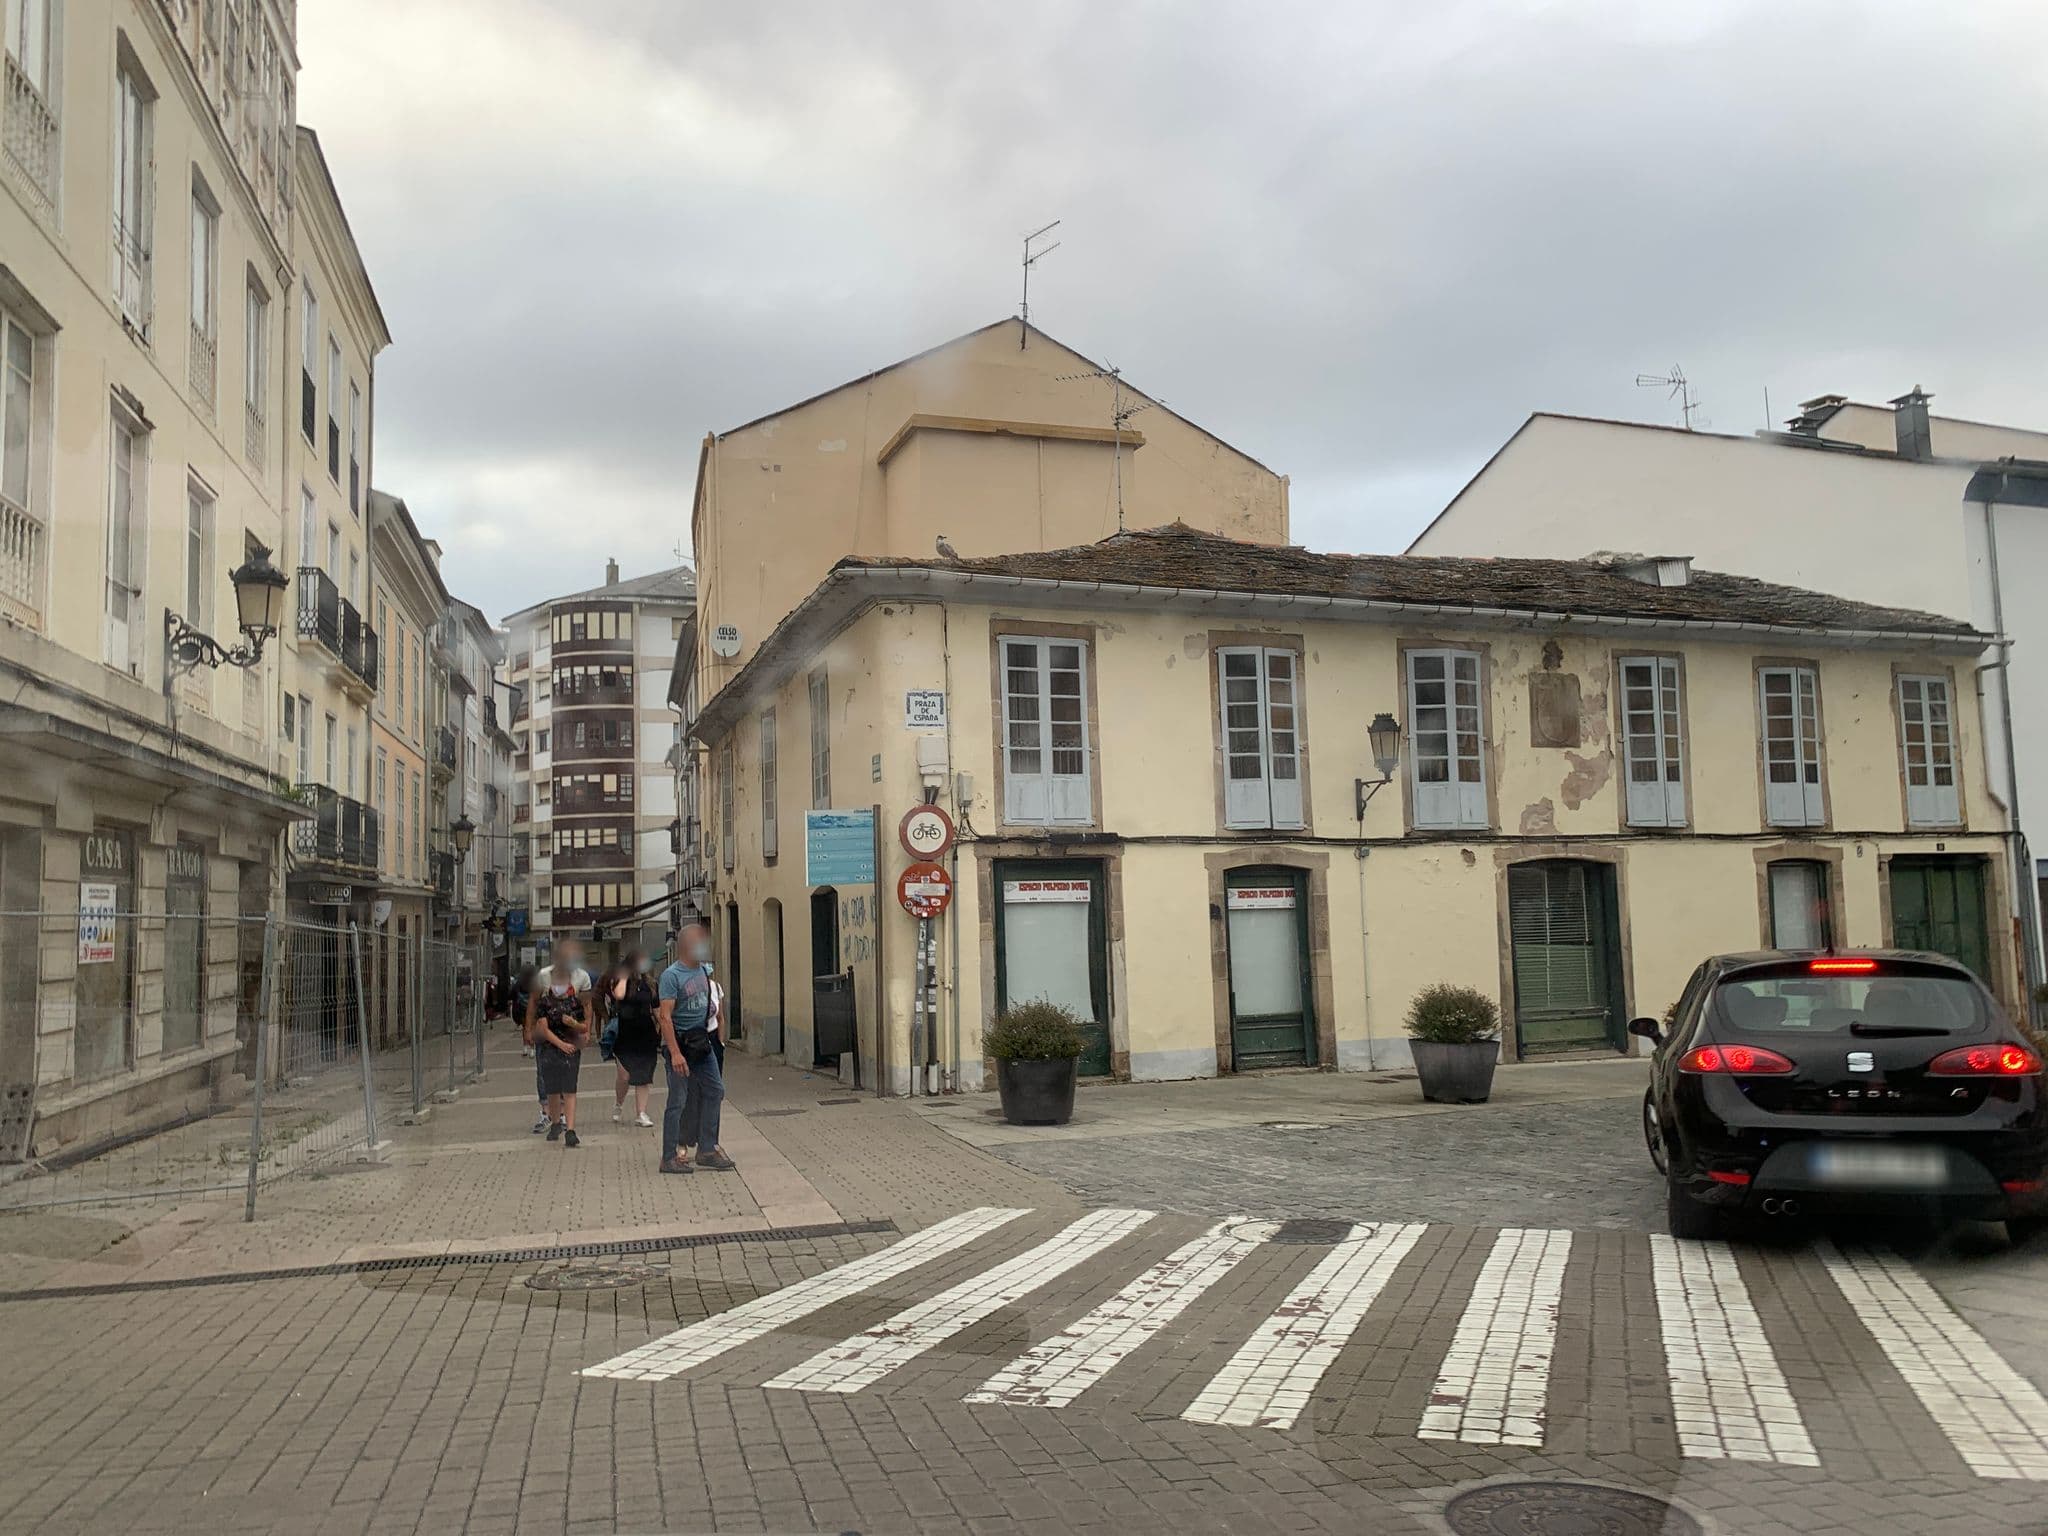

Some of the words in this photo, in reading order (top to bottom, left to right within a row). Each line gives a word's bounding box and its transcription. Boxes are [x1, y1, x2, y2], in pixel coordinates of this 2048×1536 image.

[718, 626, 738, 636] CELSO
[914, 700, 936, 708] PRAZA
[85, 836, 122, 869] CASA
